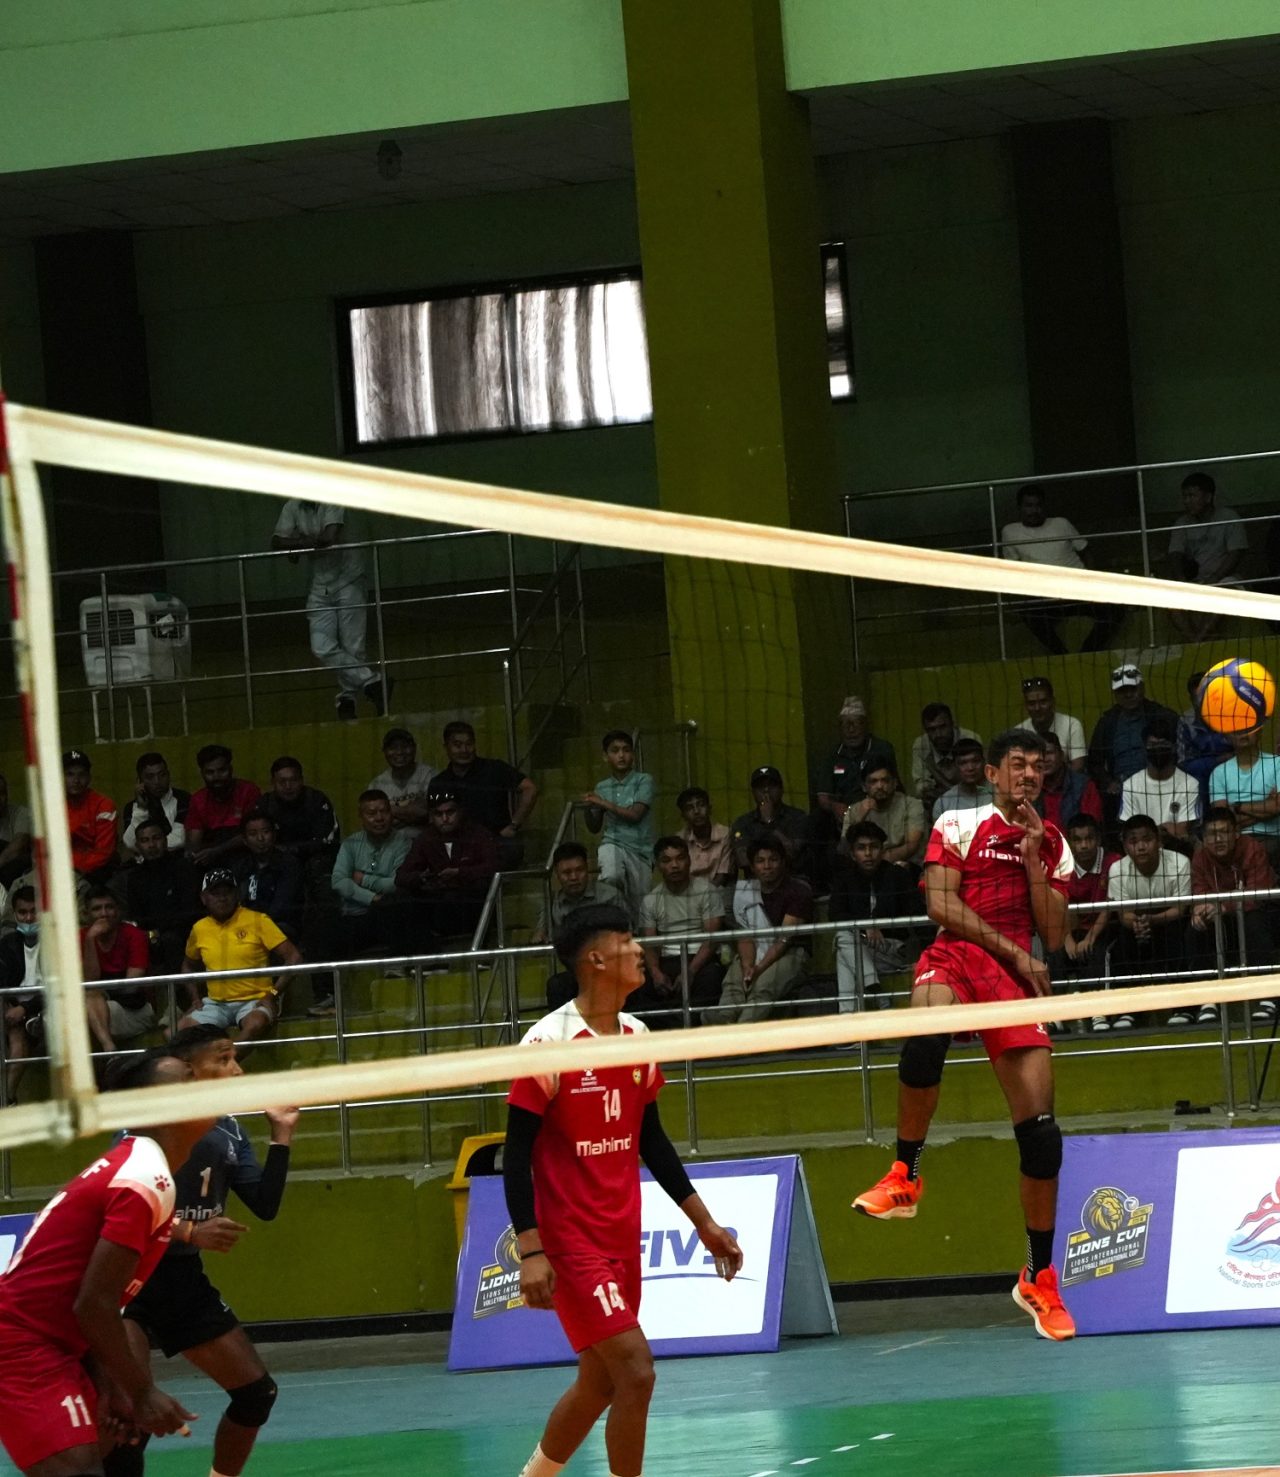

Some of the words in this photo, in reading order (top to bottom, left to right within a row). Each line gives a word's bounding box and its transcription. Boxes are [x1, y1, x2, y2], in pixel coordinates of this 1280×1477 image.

[602, 1089, 621, 1122] 14
[576, 1133, 632, 1157] Mahind
[200, 1166, 212, 1198] 1
[1068, 1236, 1111, 1259] LIONS
[1116, 1225, 1146, 1243] CUP
[1071, 1257, 1089, 1268] LIONS
[1091, 1241, 1140, 1260] INTERNATIONAL
[1071, 1262, 1098, 1275] VOLLEYBALL
[1129, 1249, 1139, 1257] CUP
[480, 1270, 520, 1291] LIONS
[1241, 1280, 1263, 1288] Sports
[483, 1289, 501, 1300] LIONS
[593, 1281, 626, 1317] 14
[61, 1394, 92, 1427] 11
